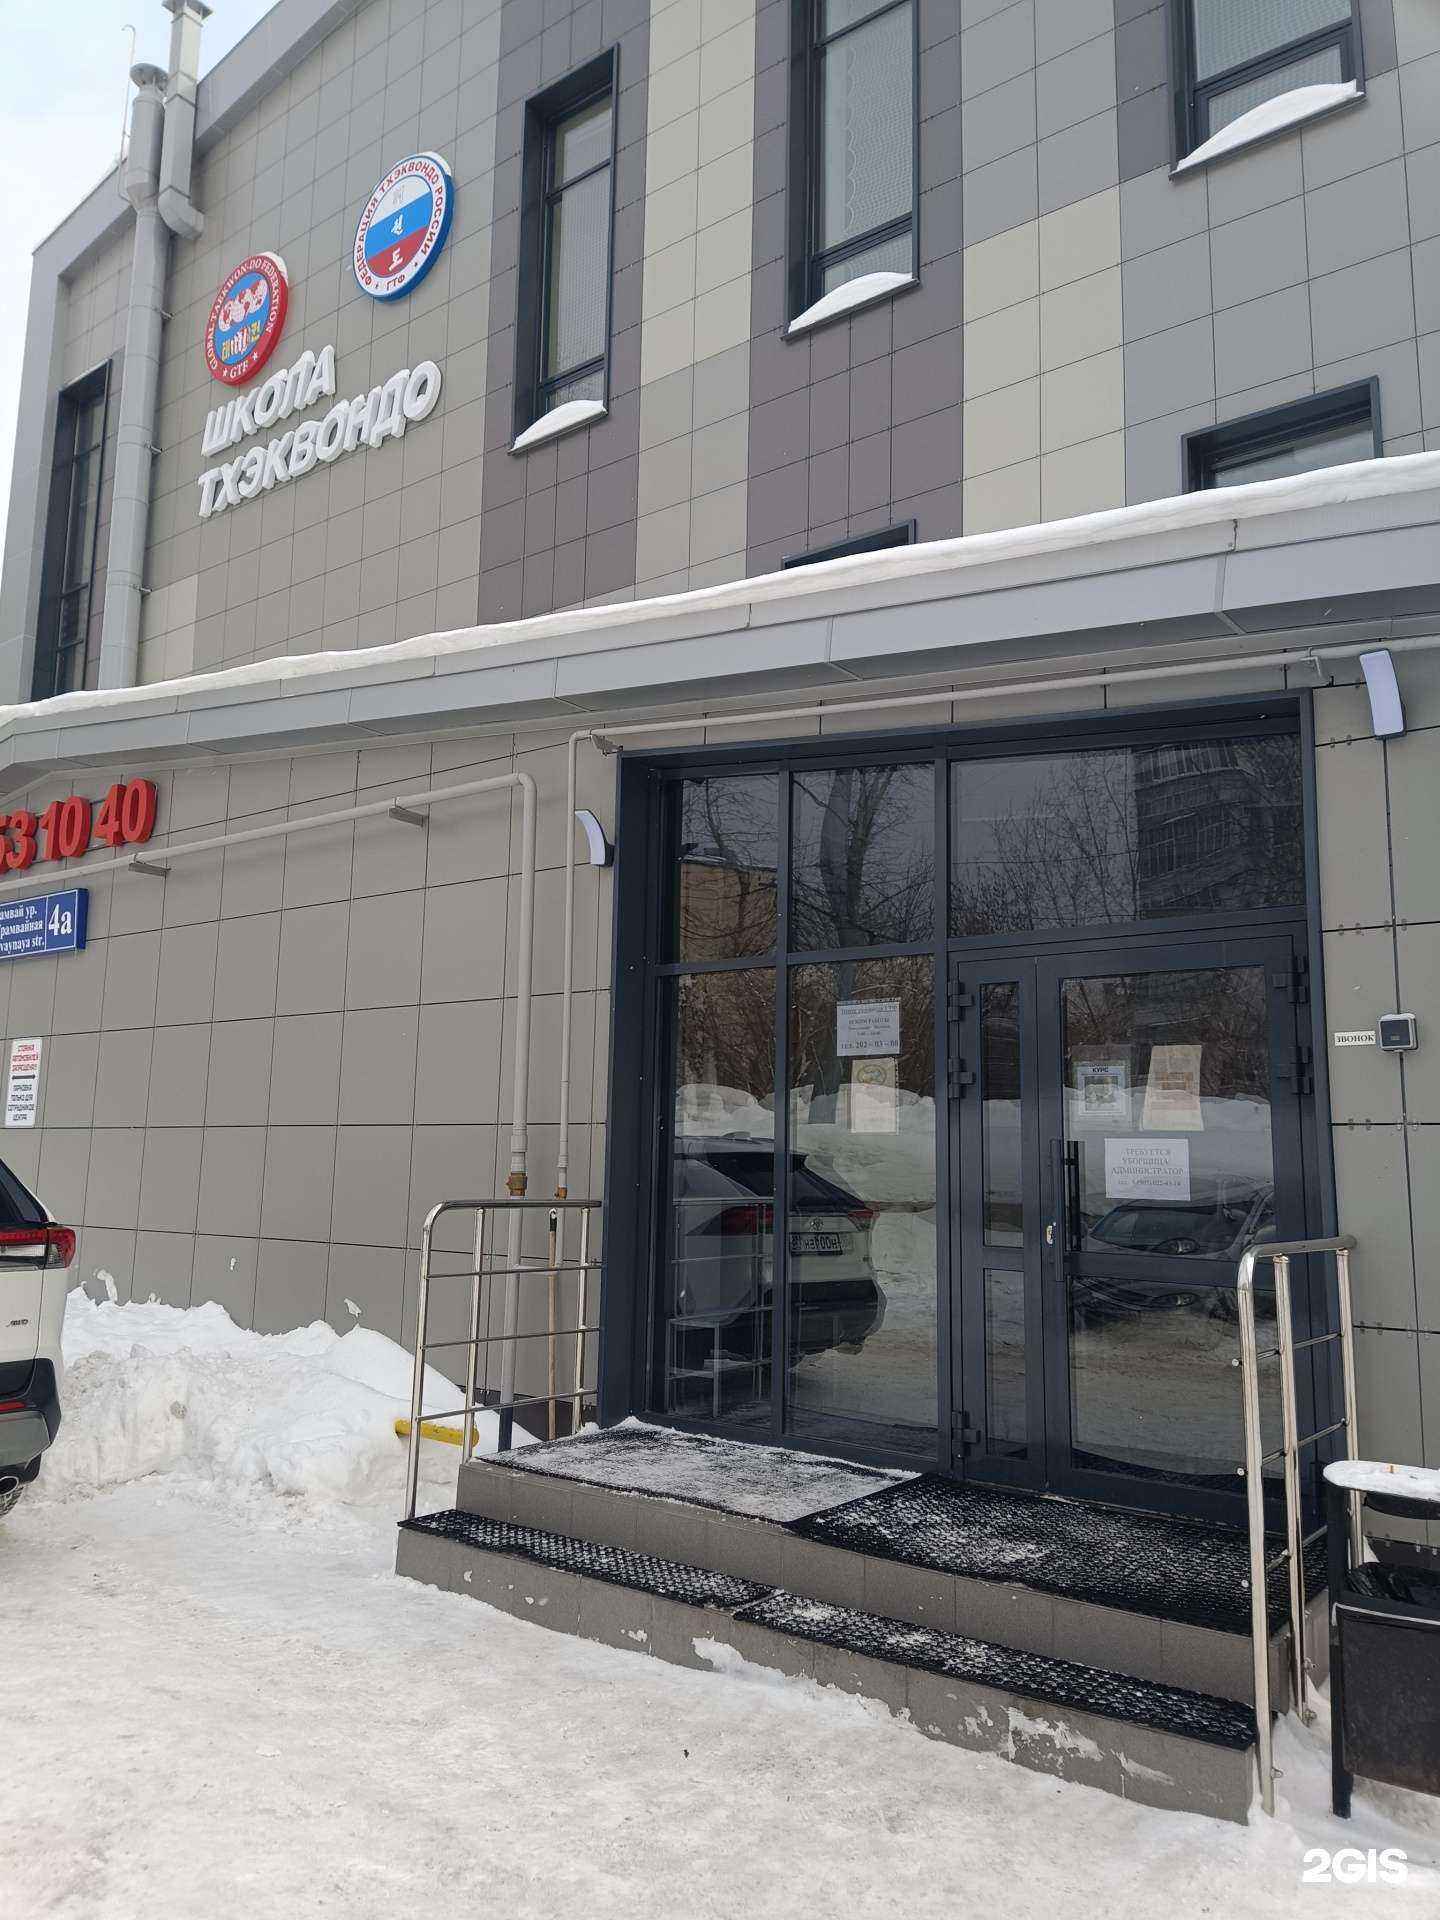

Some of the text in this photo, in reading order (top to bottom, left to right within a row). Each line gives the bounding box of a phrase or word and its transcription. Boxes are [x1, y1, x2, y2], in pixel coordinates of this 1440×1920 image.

[378, 160, 440, 193] ТХЭКВОНДО
[421, 188, 443, 256] РОССИИ
[260, 260, 281, 333] FEDERATION
[386, 273, 407, 291] ГТФ
[201, 344, 336, 457] ШКОЛА
[229, 361, 249, 379] GTF
[198, 360, 442, 518] ТХЭКВОНДО
[40, 796, 91, 861] 10
[94, 778, 157, 846] 40
[0, 920, 43, 939] рамвайная
[1336, 1034, 1375, 1043] ЗВОНОК
